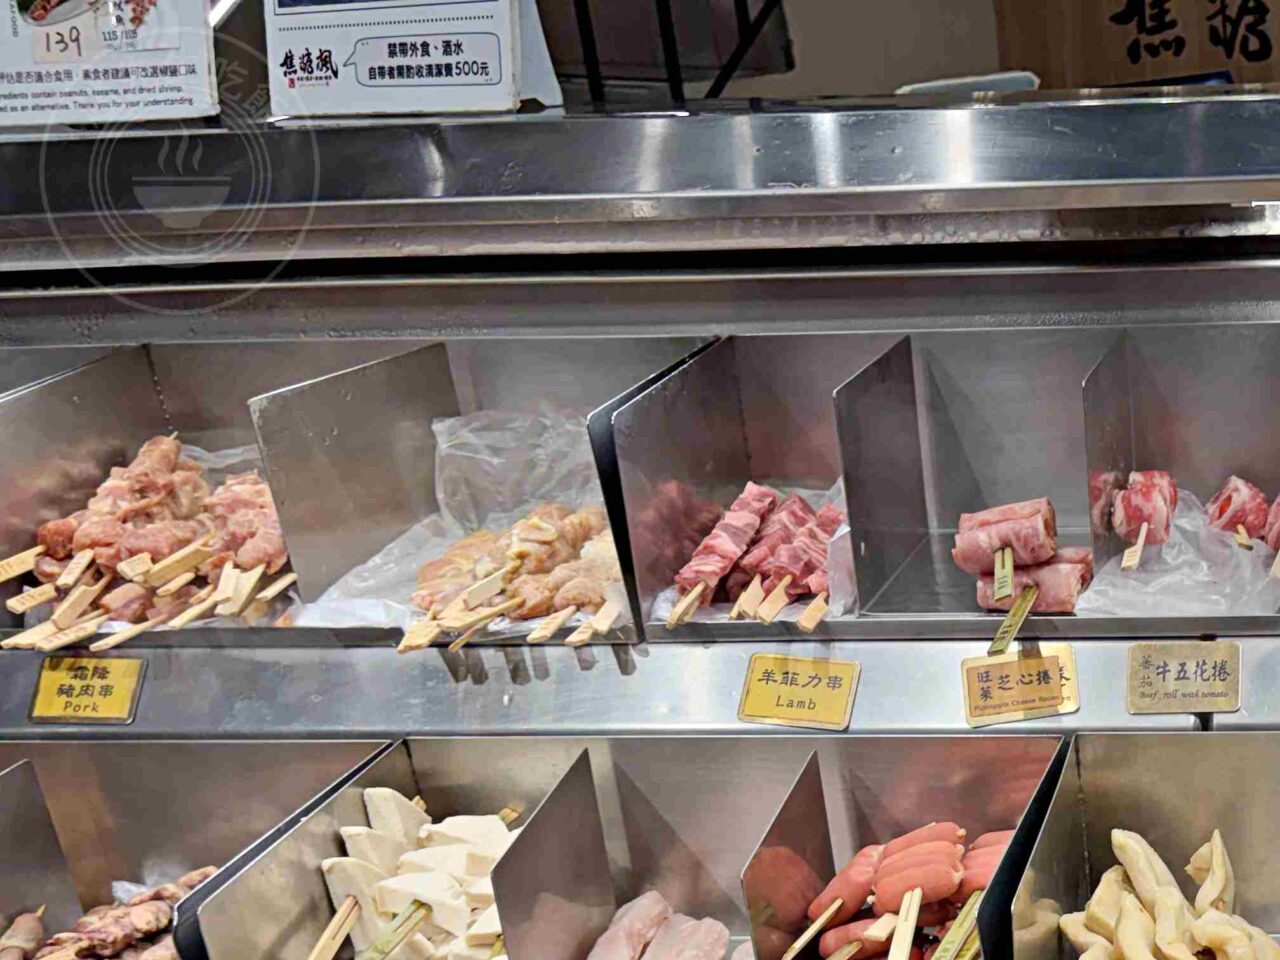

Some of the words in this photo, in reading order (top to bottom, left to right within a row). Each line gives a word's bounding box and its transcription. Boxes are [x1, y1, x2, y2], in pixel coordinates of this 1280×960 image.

[45, 26, 82, 57] 139
[757, 668, 844, 691] 羊菲力串
[56, 683, 115, 698] 豬肉串
[63, 701, 100, 713] Pork
[775, 695, 817, 710] Lamb
